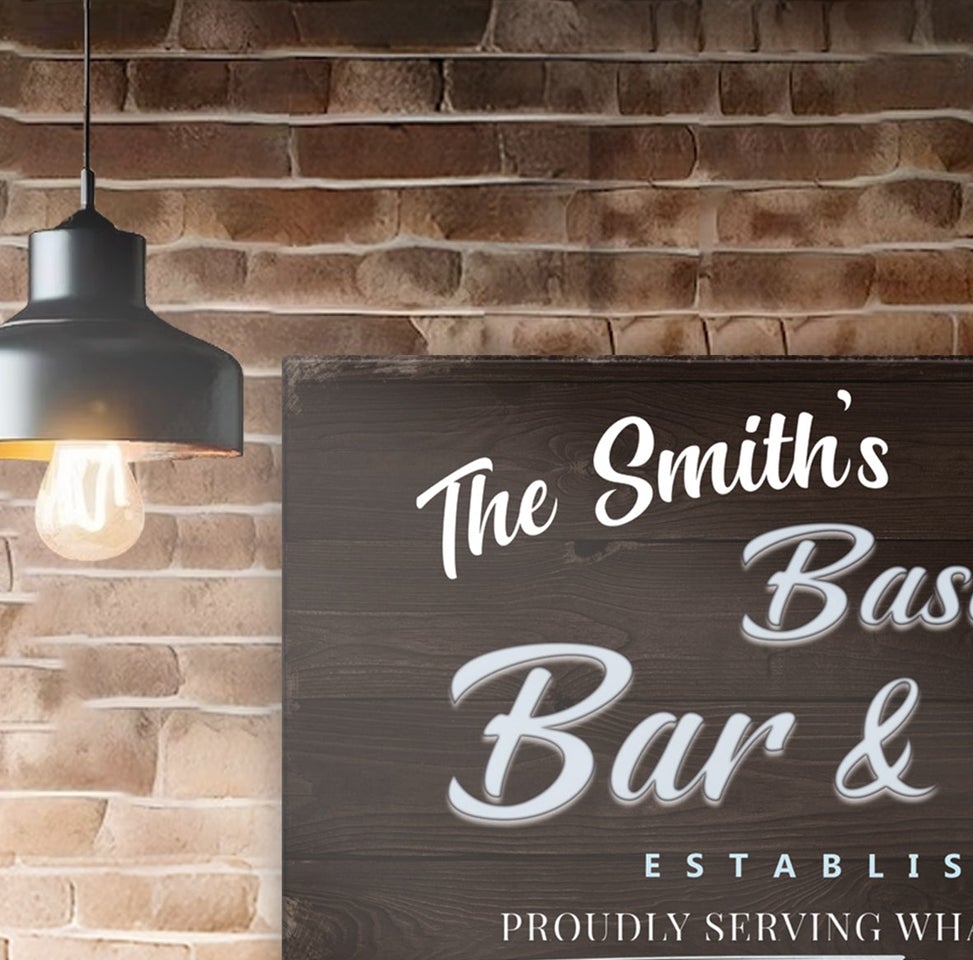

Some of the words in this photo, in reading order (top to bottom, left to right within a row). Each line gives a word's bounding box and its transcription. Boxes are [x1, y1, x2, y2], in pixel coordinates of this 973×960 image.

[416, 456, 558, 580] The
[593, 389, 890, 527] Smith's
[448, 643, 796, 826] Bar
[835, 678, 934, 803] &
[501, 911, 691, 943] PROUDLY
[704, 911, 881, 943] SERVING
